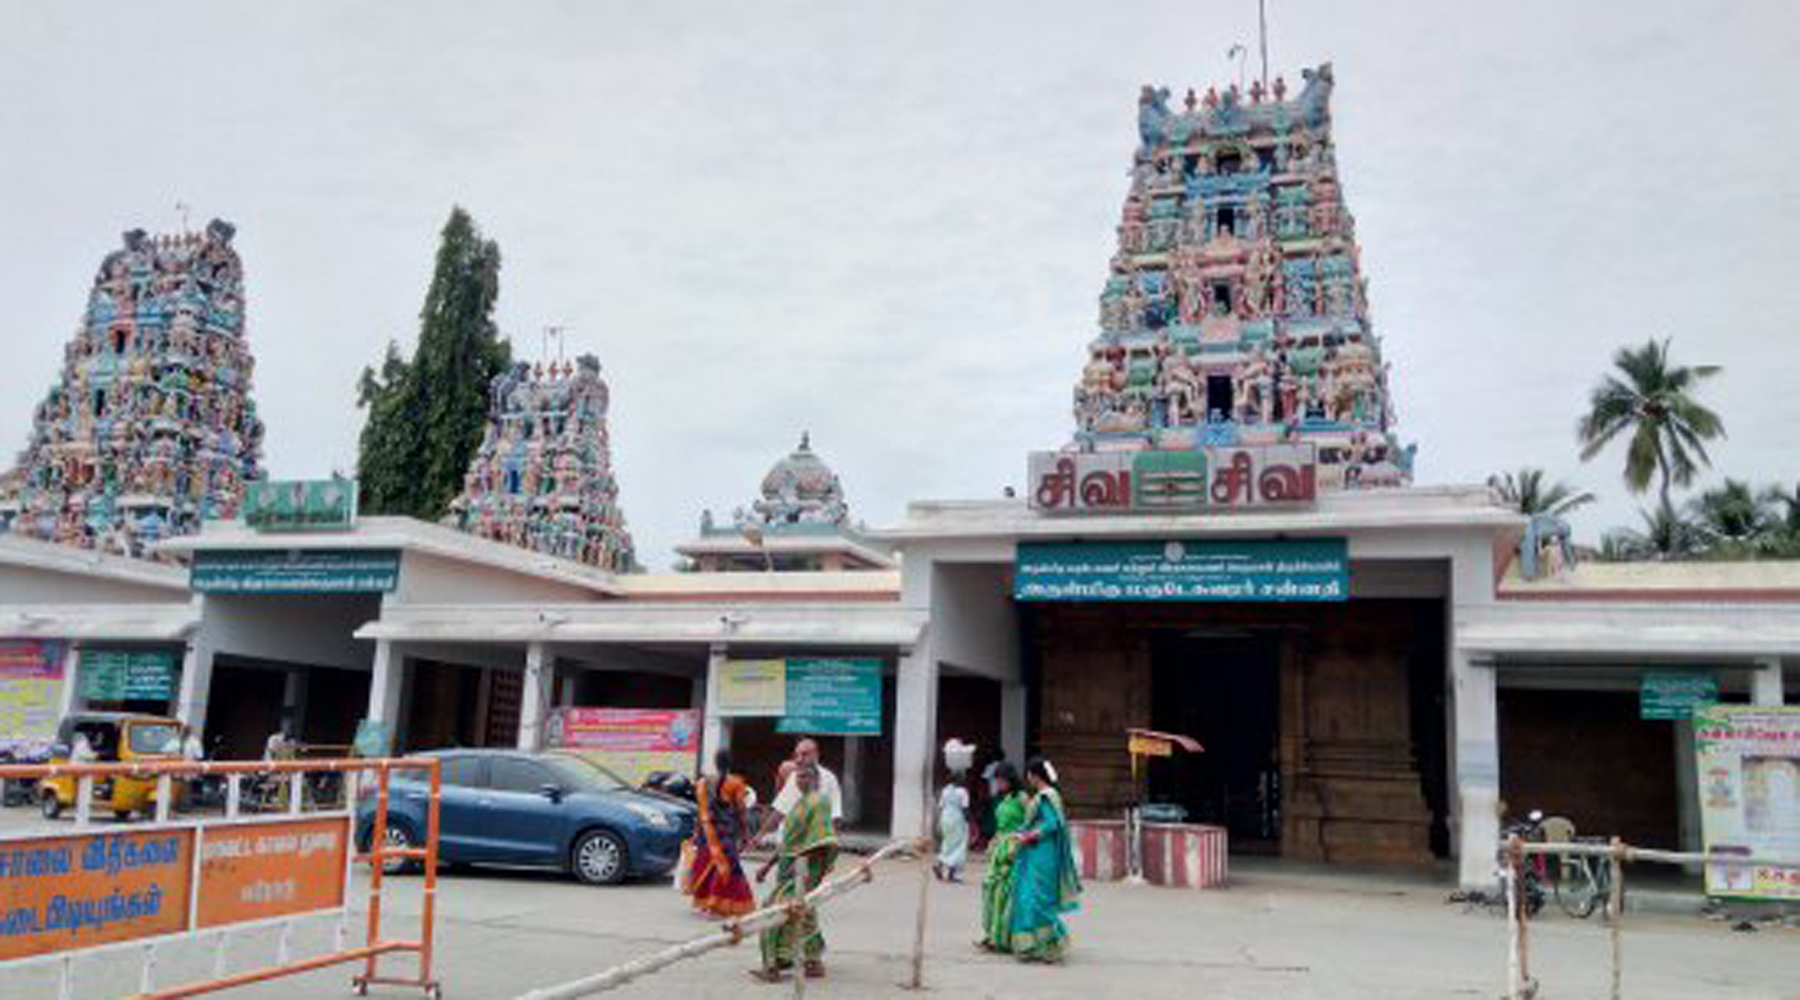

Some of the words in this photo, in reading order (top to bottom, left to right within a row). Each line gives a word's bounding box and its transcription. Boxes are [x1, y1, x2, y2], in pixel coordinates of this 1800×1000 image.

[1037, 457, 1129, 508] சிவ
[1210, 450, 1315, 503] சிவ
[1020, 581, 1121, 598] அருள்மிகு
[1260, 579, 1340, 597] சன்னதி
